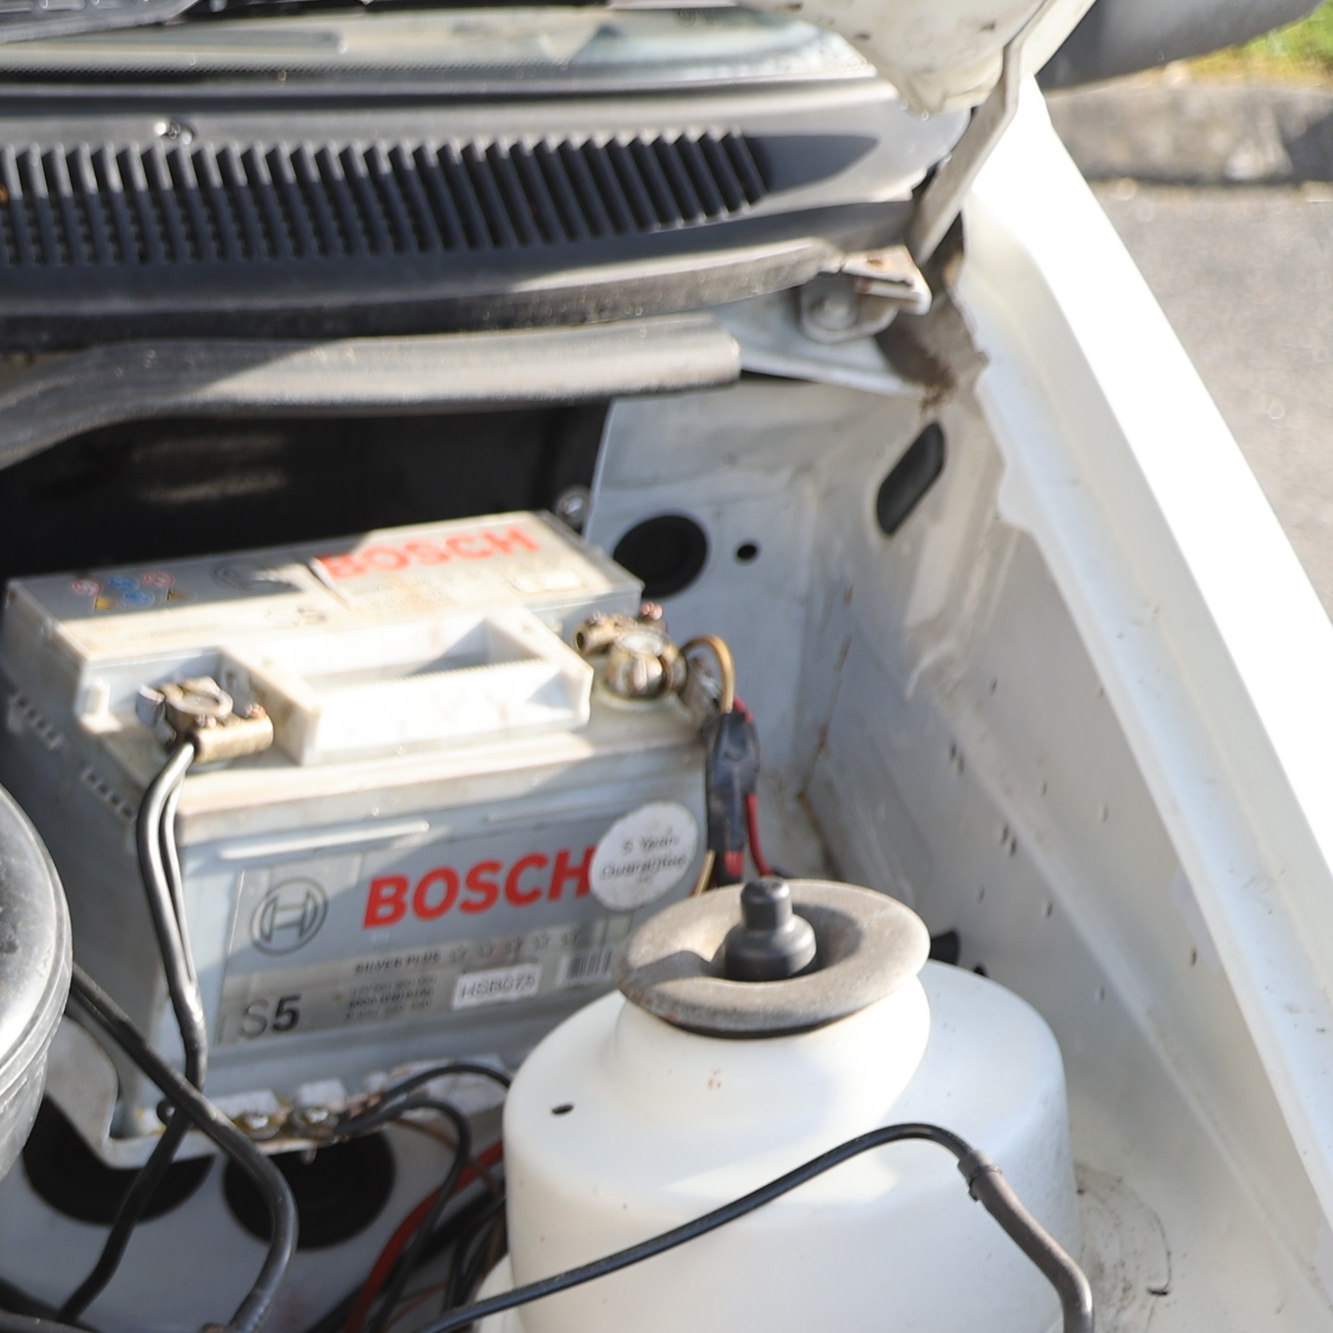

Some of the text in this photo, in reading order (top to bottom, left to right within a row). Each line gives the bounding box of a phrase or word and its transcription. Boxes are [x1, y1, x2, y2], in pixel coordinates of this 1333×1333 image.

[315, 526, 541, 580] BOSCH
[362, 845, 597, 930] BOSCH
[238, 994, 301, 1040] S5
